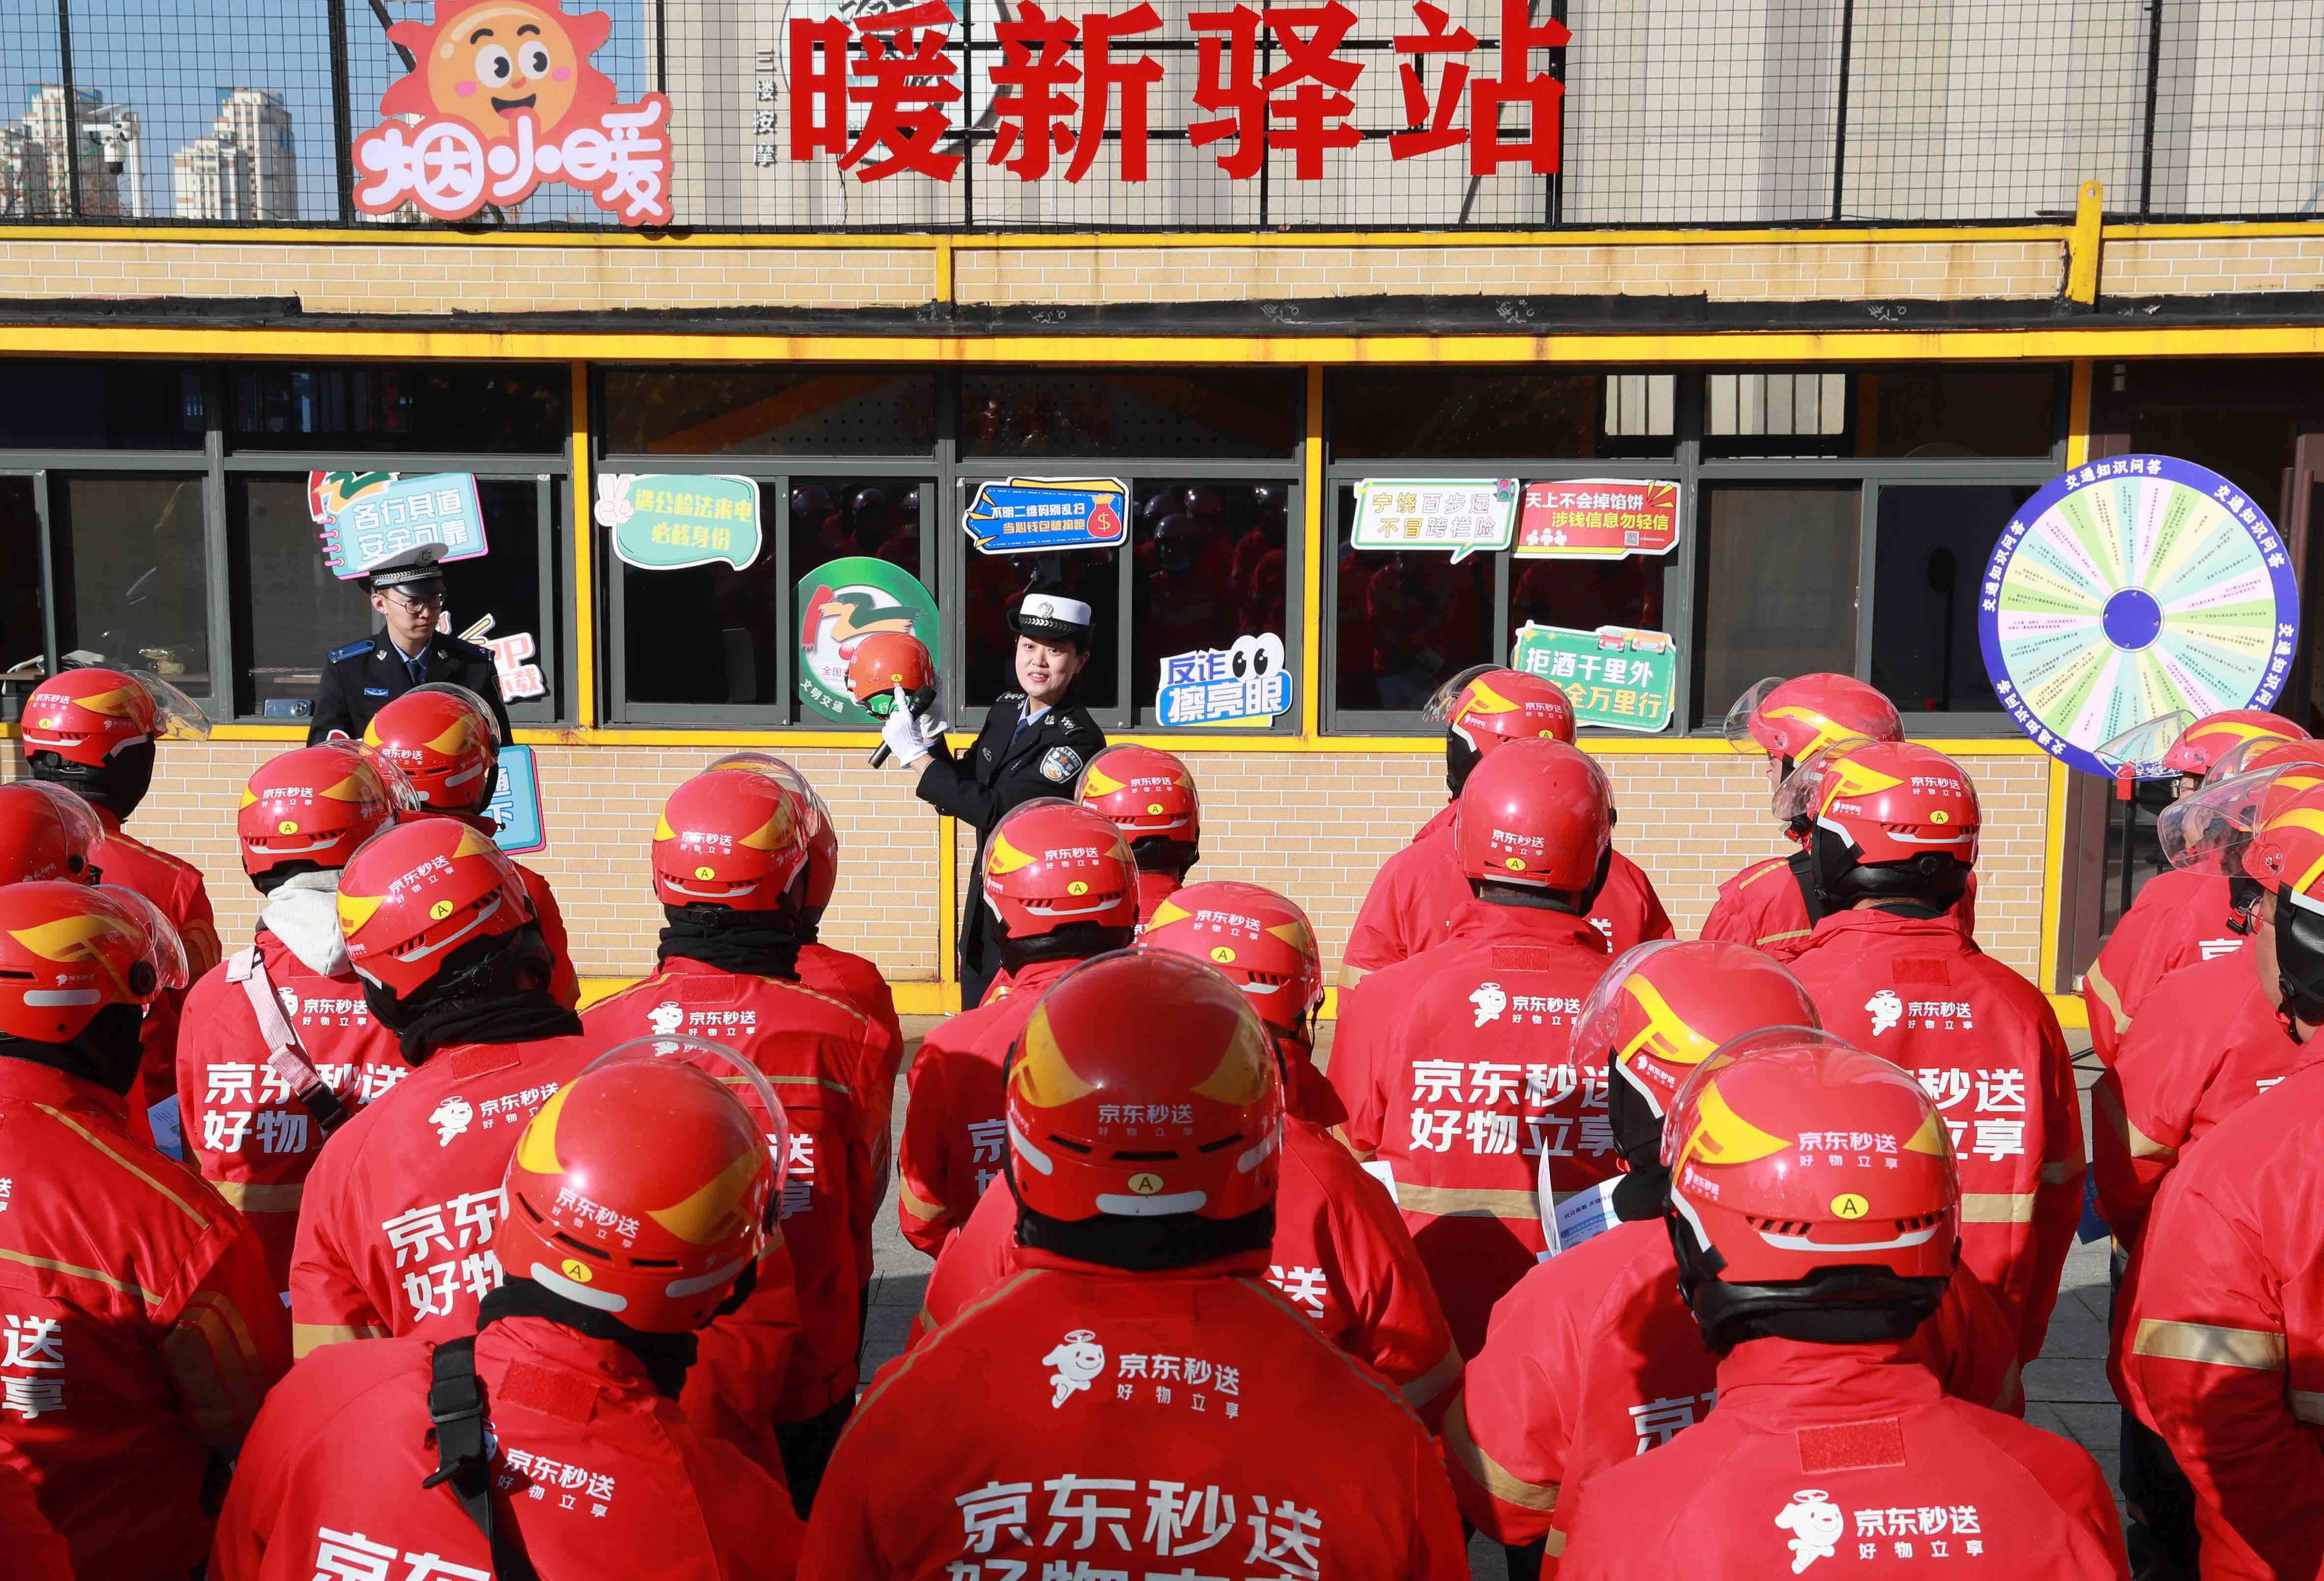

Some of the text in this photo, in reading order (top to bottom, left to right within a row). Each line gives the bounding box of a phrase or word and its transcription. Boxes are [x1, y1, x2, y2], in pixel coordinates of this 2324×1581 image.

[789, 0, 1572, 183] 暖新驿站
[754, 49, 778, 167] 三楼按摩
[361, 101, 663, 216] 烟小暖
[2065, 458, 2162, 490] 交通知识问答
[991, 502, 1085, 519] 不明二维码别乱扫
[1525, 492, 1643, 511] 天上不会掉馅饼
[1378, 517, 1496, 538] 不冒跨栏险
[1551, 511, 1669, 531] 涉钱信息勿轻信
[2213, 484, 2286, 569] 交通知识问答
[1982, 520, 2026, 613] 交通知识问答
[1167, 653, 1226, 684] 反诈
[1525, 647, 1653, 688] 拒酒千里外
[800, 678, 844, 713] 文明交通
[1168, 675, 1282, 723] 擦亮眼
[1549, 679, 1662, 719] 全万里行
[1996, 678, 2066, 755] 交通知识问答
[1131, 777, 1172, 786] 京东秒送
[1911, 776, 1961, 790] 京东秒送
[262, 787, 314, 798] 京东秒送
[284, 823, 292, 832] A
[1936, 813, 1944, 821] A
[681, 830, 732, 846] 京东秒送
[1491, 828, 1545, 848] 京东秒送
[1045, 847, 1099, 861] 京东秒送
[1511, 860, 1519, 868] A
[387, 854, 450, 896] 京东秒送
[700, 869, 709, 878] A
[1074, 884, 1082, 893] A
[437, 905, 449, 917] A
[1195, 909, 1261, 932] 京东秒送
[1219, 950, 1228, 961] A
[303, 999, 368, 1015] 京东秒送
[1512, 995, 1581, 1014] 京东秒送
[1908, 1001, 1972, 1018] 京东秒送
[302, 1017, 367, 1026] 好物立享
[689, 1010, 755, 1025] 京东秒送
[1908, 1020, 1973, 1030] 好物立享
[689, 1026, 755, 1036] 好物立享
[479, 1082, 559, 1119] 京东秒送
[1098, 1104, 1194, 1125] 京东秒送
[1408, 1107, 1615, 1157] 好物立享
[1798, 1132, 1898, 1154] 京东秒送
[1138, 1176, 1153, 1192] A
[555, 1187, 640, 1239] 京东秒送
[1842, 1198, 1858, 1214] A
[569, 1264, 582, 1279] A
[1, 1314, 65, 1368] 送
[1118, 1353, 1239, 1396] 京东秒送
[1, 1375, 66, 1419] 享
[1116, 1383, 1239, 1419] 好物立享
[1628, 1391, 1717, 1456] 京
[505, 1448, 615, 1501] 京东秒送
[496, 1474, 608, 1518] 好物立享
[955, 1474, 1322, 1581] 京东秒送
[1854, 1504, 1980, 1538] 京东秒送
[1858, 1540, 1984, 1560] 好物立享
